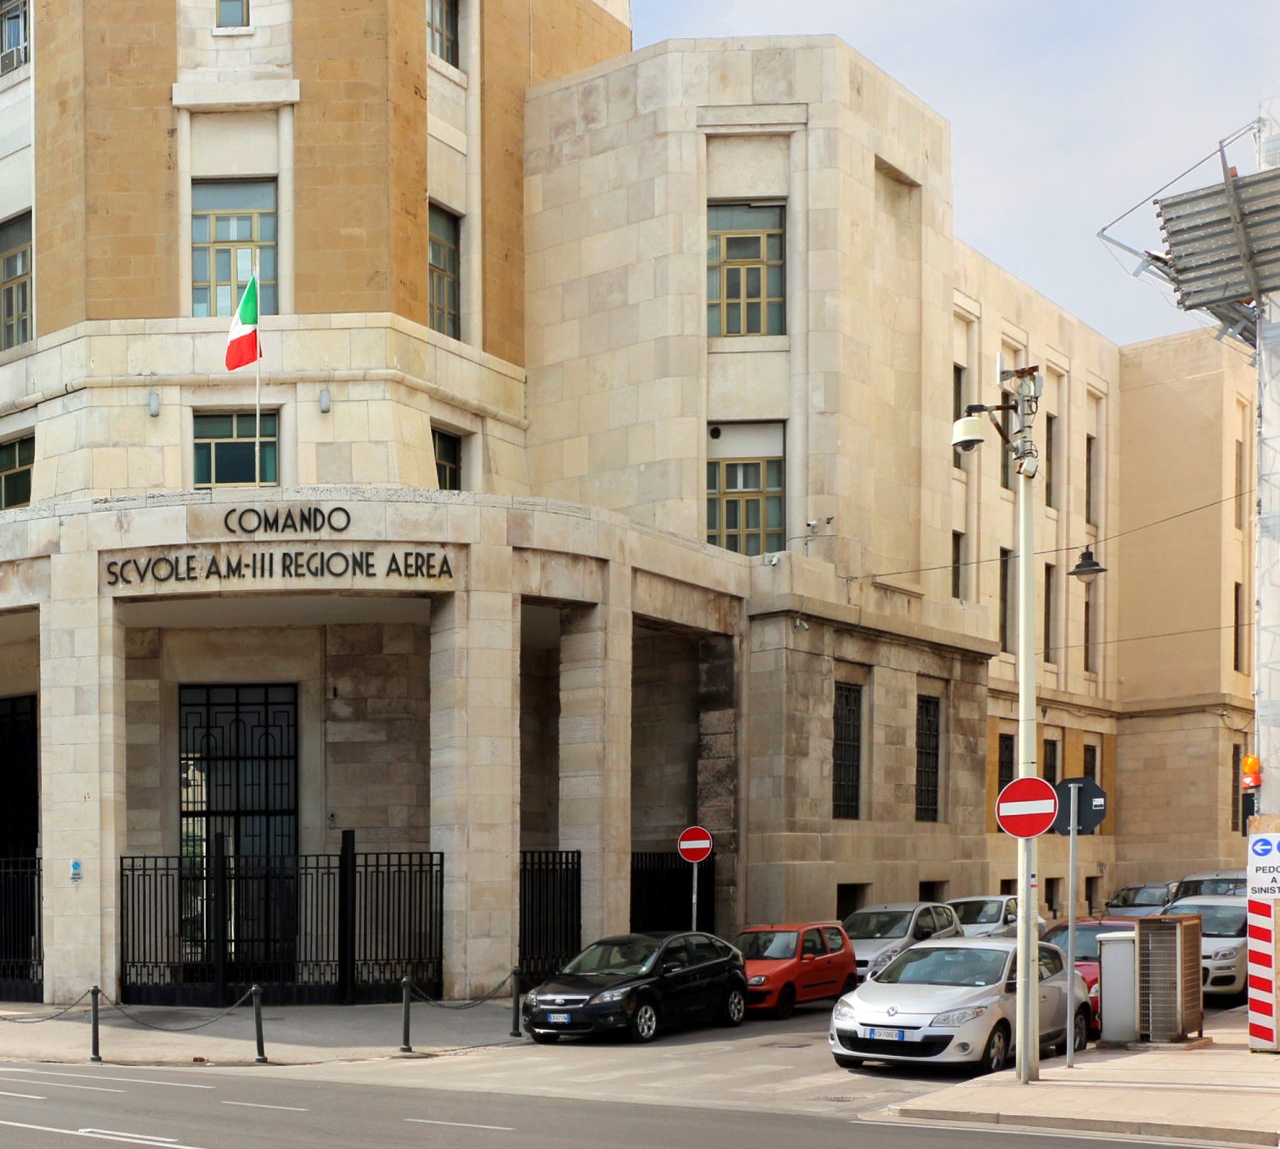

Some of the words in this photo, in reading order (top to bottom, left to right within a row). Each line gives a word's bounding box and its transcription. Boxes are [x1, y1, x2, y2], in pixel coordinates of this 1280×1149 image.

[224, 506, 351, 534] COMANDO
[107, 555, 198, 586] SCVOLE
[281, 551, 377, 579] REGIONE
[386, 551, 454, 579] AEREA
[1271, 876, 1278, 884] A
